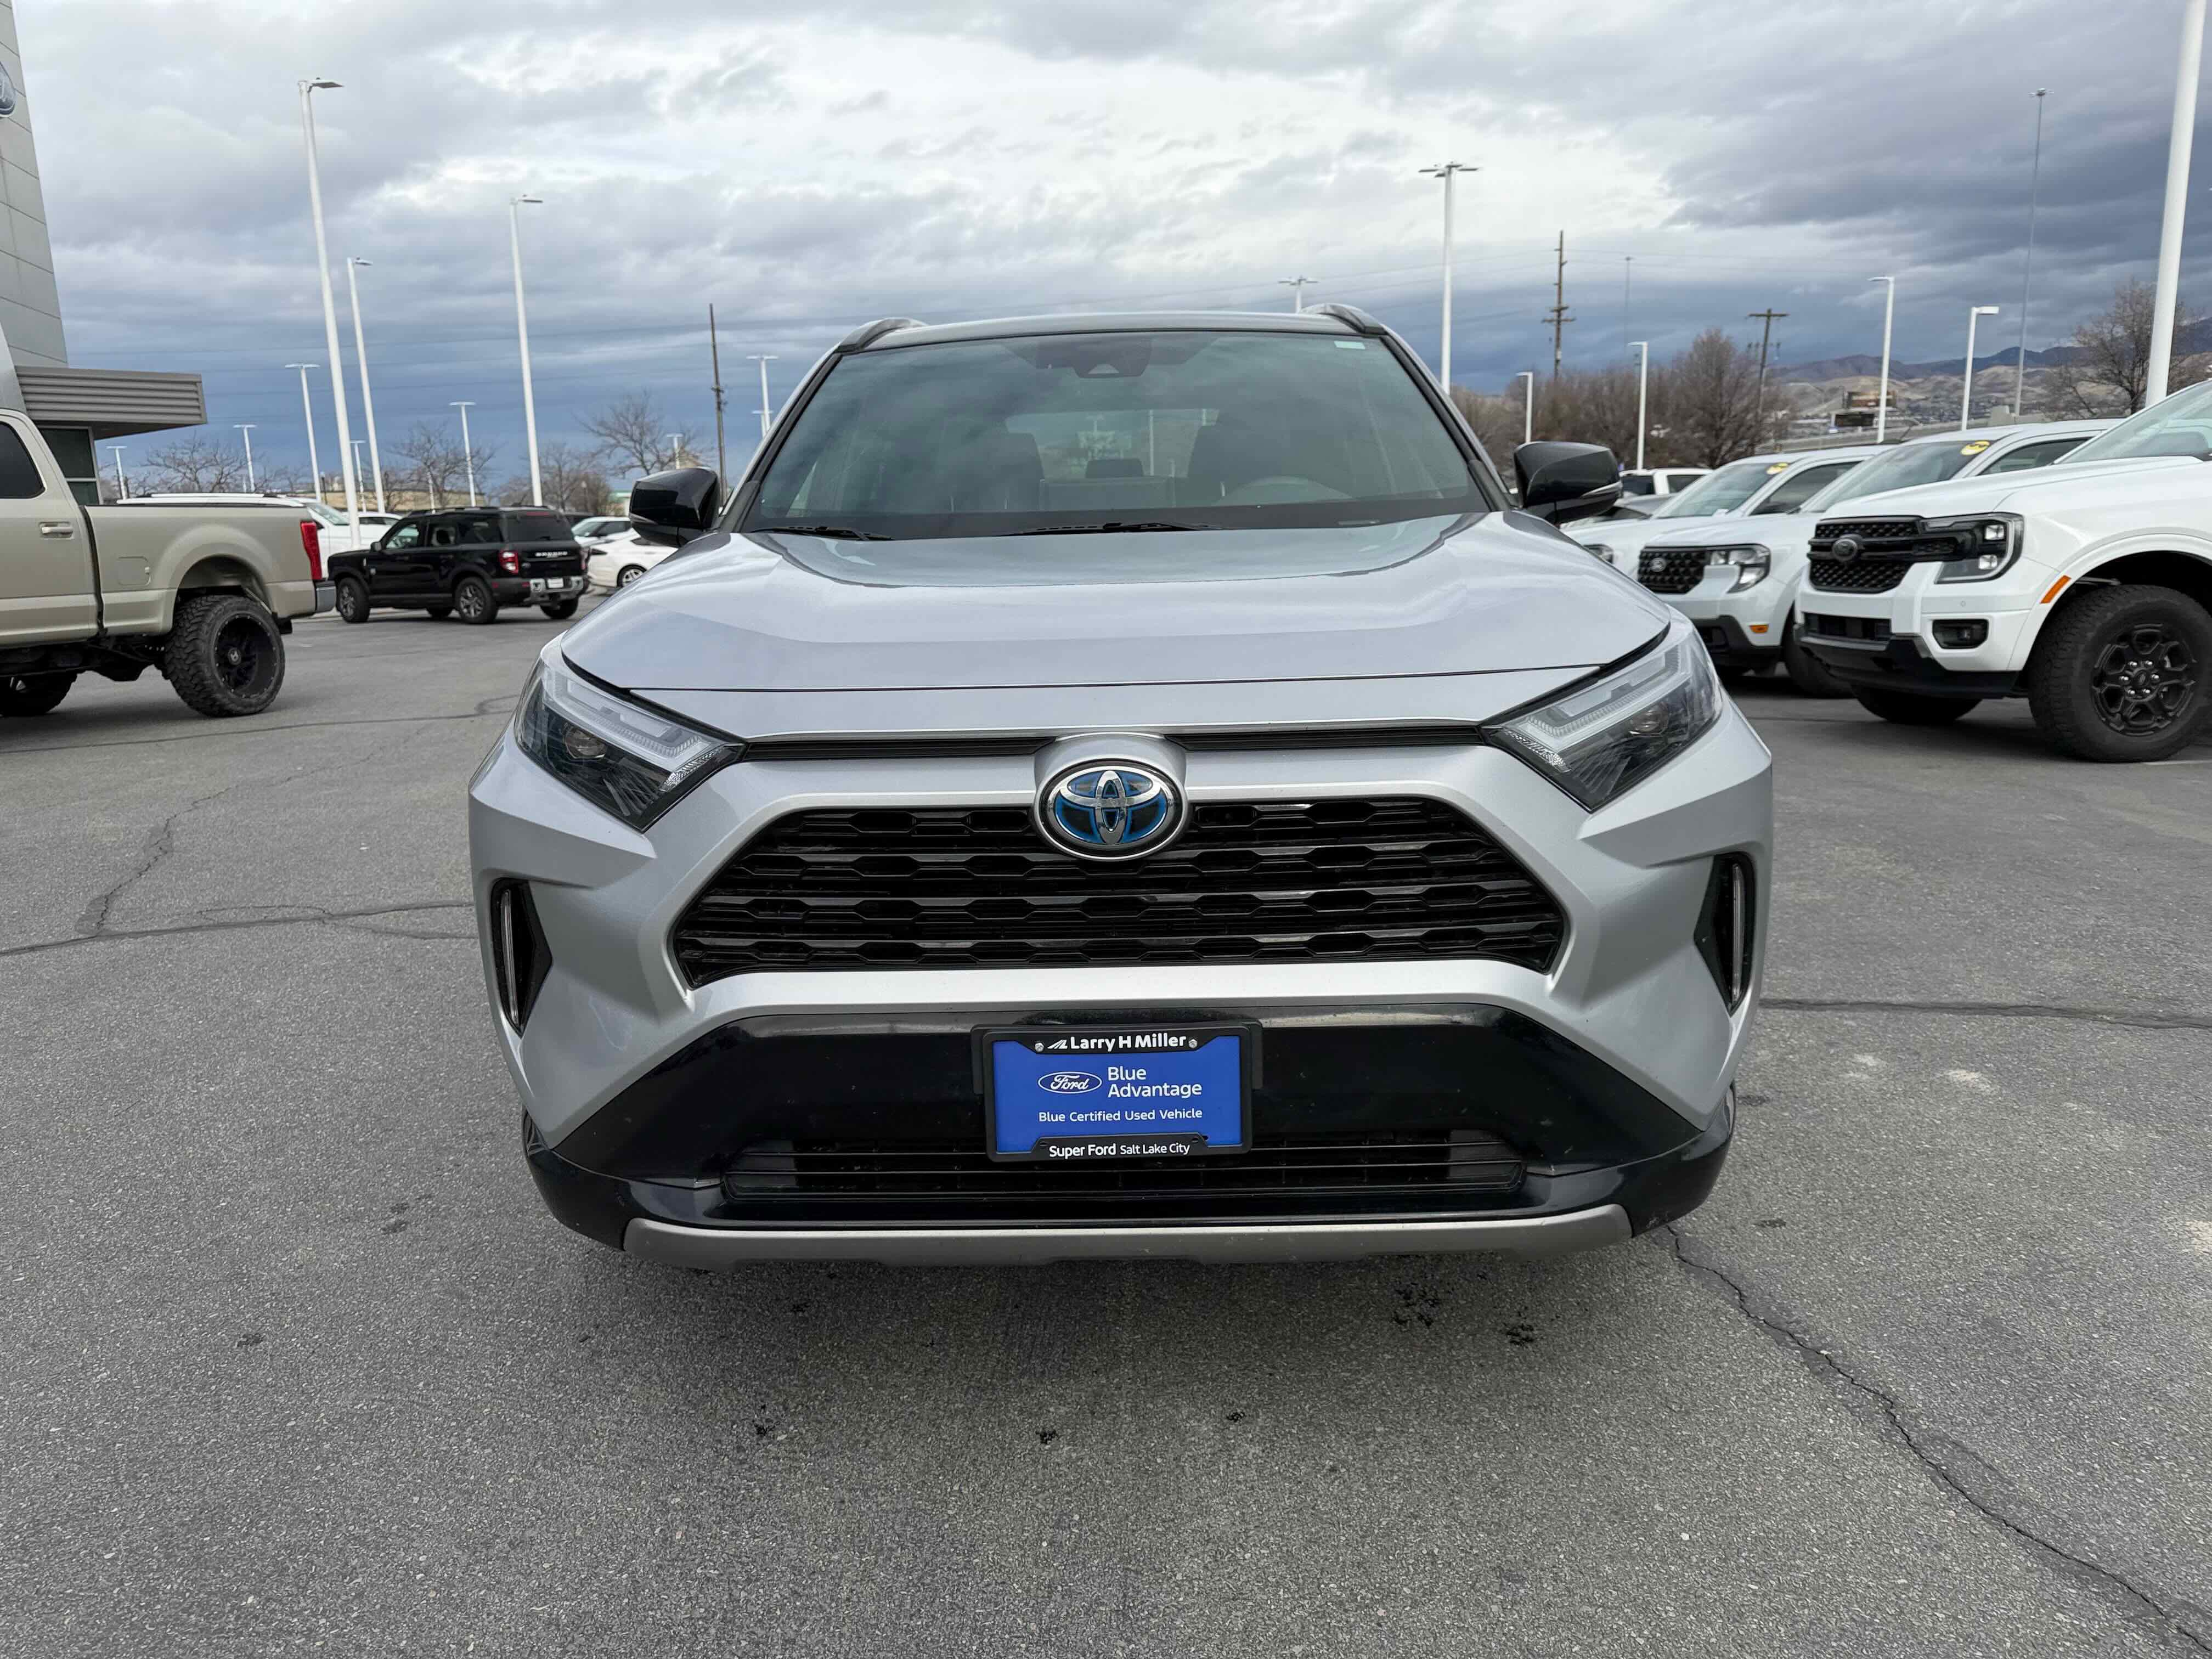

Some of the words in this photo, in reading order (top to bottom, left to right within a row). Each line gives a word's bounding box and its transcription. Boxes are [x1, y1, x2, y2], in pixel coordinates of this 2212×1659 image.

[1070, 1036, 1115, 1052] Larry
[1119, 1035, 1132, 1048] H
[1135, 1032, 1187, 1048] Miller
[1108, 1065, 1147, 1081] Blue
[1050, 1074, 1090, 1091] Ford
[1108, 1082, 1202, 1098] Advantage
[1039, 1111, 1065, 1122] Blue
[1069, 1110, 1121, 1122] Certified
[1125, 1109, 1155, 1120] Used
[1159, 1108, 1203, 1120] Vehicle
[1049, 1146, 1086, 1159] Super
[1088, 1143, 1116, 1156] Ford
[1120, 1144, 1141, 1155] Salt
[1142, 1143, 1167, 1154] Lake
[1169, 1142, 1190, 1155] City
